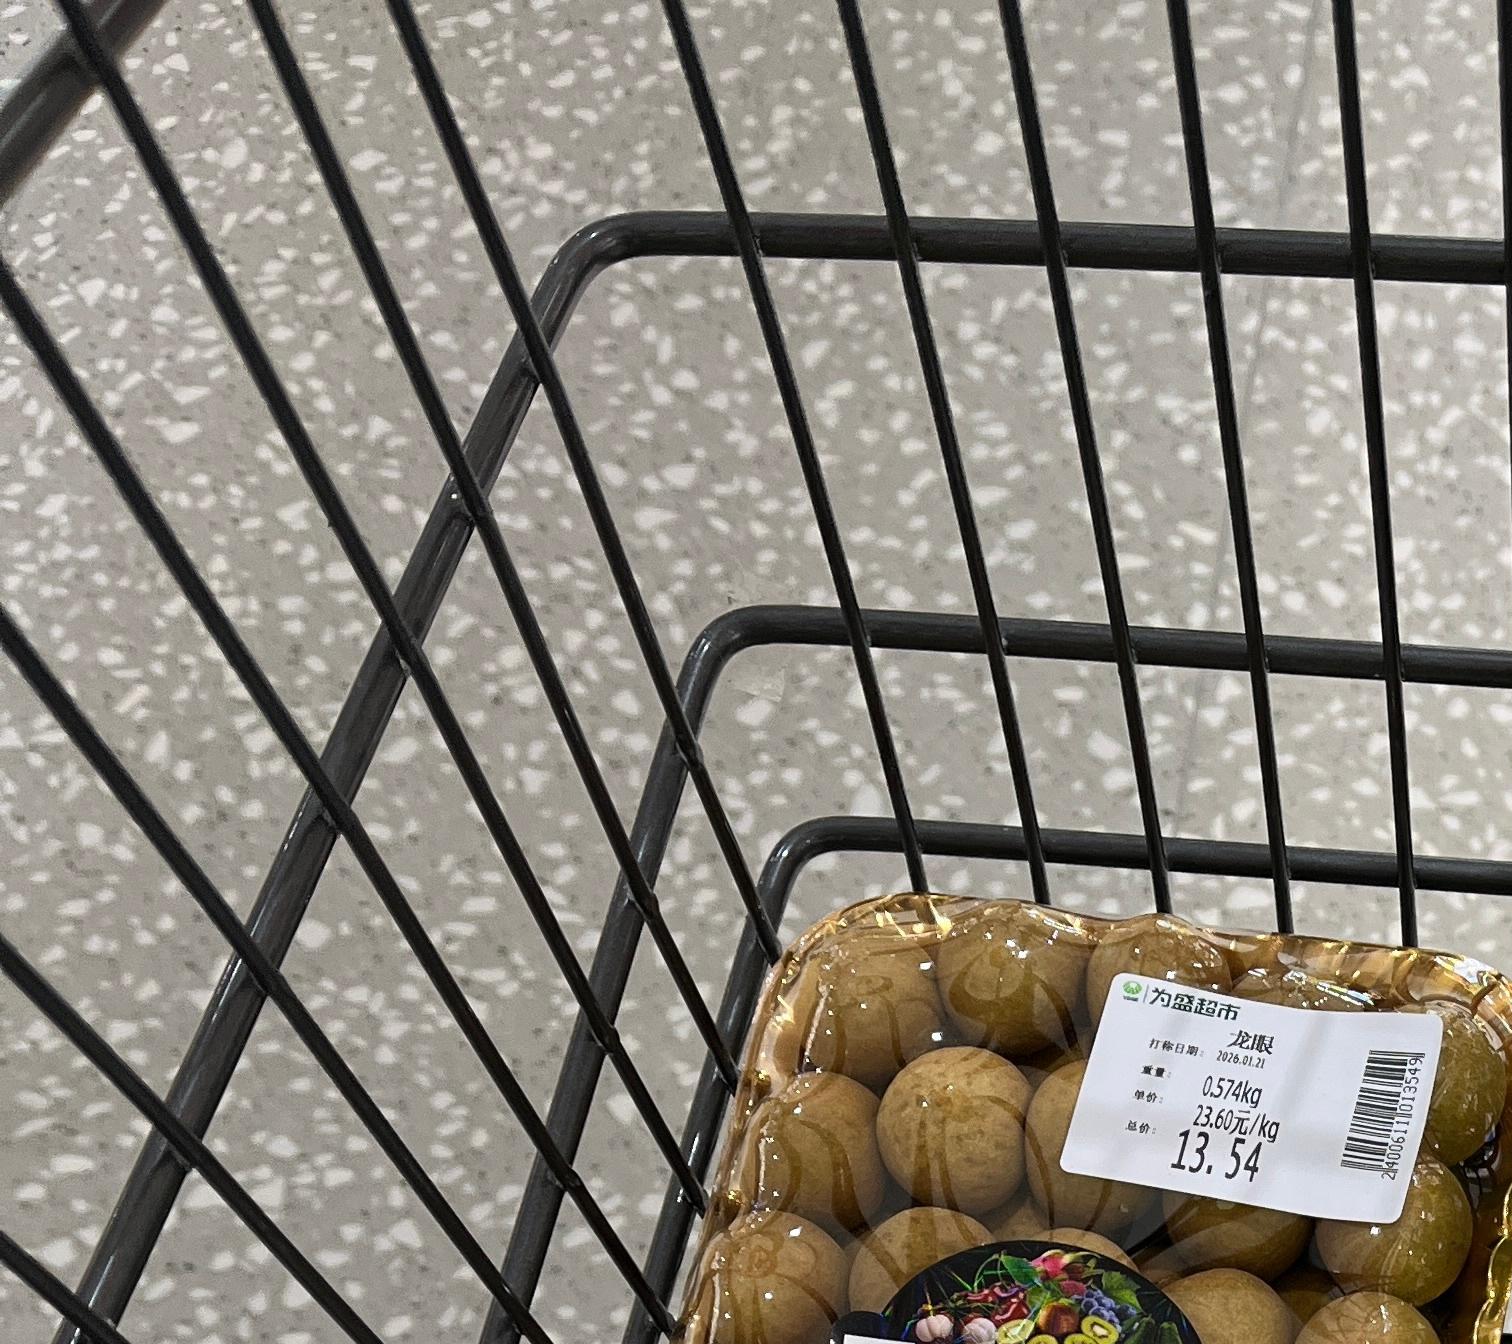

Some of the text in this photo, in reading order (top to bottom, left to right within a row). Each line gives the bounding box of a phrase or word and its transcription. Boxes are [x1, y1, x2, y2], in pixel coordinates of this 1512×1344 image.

[1148, 986, 1241, 1021] 为盛超市
[1226, 1028, 1275, 1056] 龙眼
[1216, 1050, 1266, 1070] 2026.01.21
[1202, 1075, 1263, 1109] 0.574kg
[1192, 1104, 1281, 1144] 23.60元/kg
